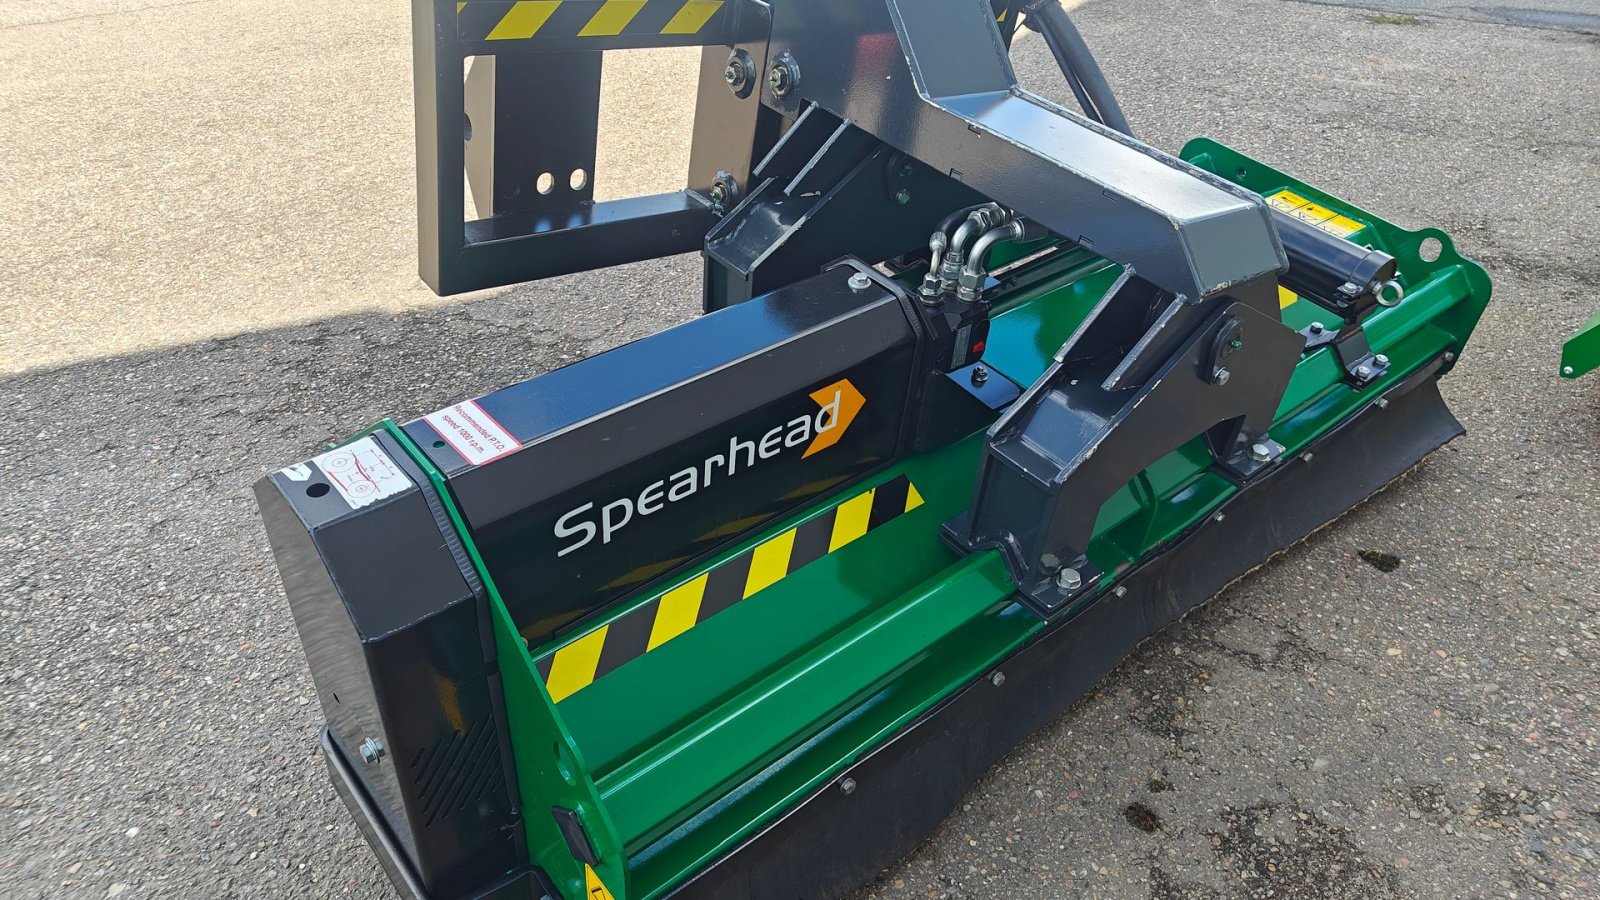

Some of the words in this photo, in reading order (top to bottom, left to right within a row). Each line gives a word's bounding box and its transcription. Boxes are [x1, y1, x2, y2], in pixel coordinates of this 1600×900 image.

[442, 415, 461, 430] speed
[458, 428, 473, 441] 1000
[469, 440, 485, 454] r.p.m.
[454, 405, 491, 438] Recommended
[489, 437, 505, 452] P.T.O.
[553, 390, 842, 557] Spearhead
